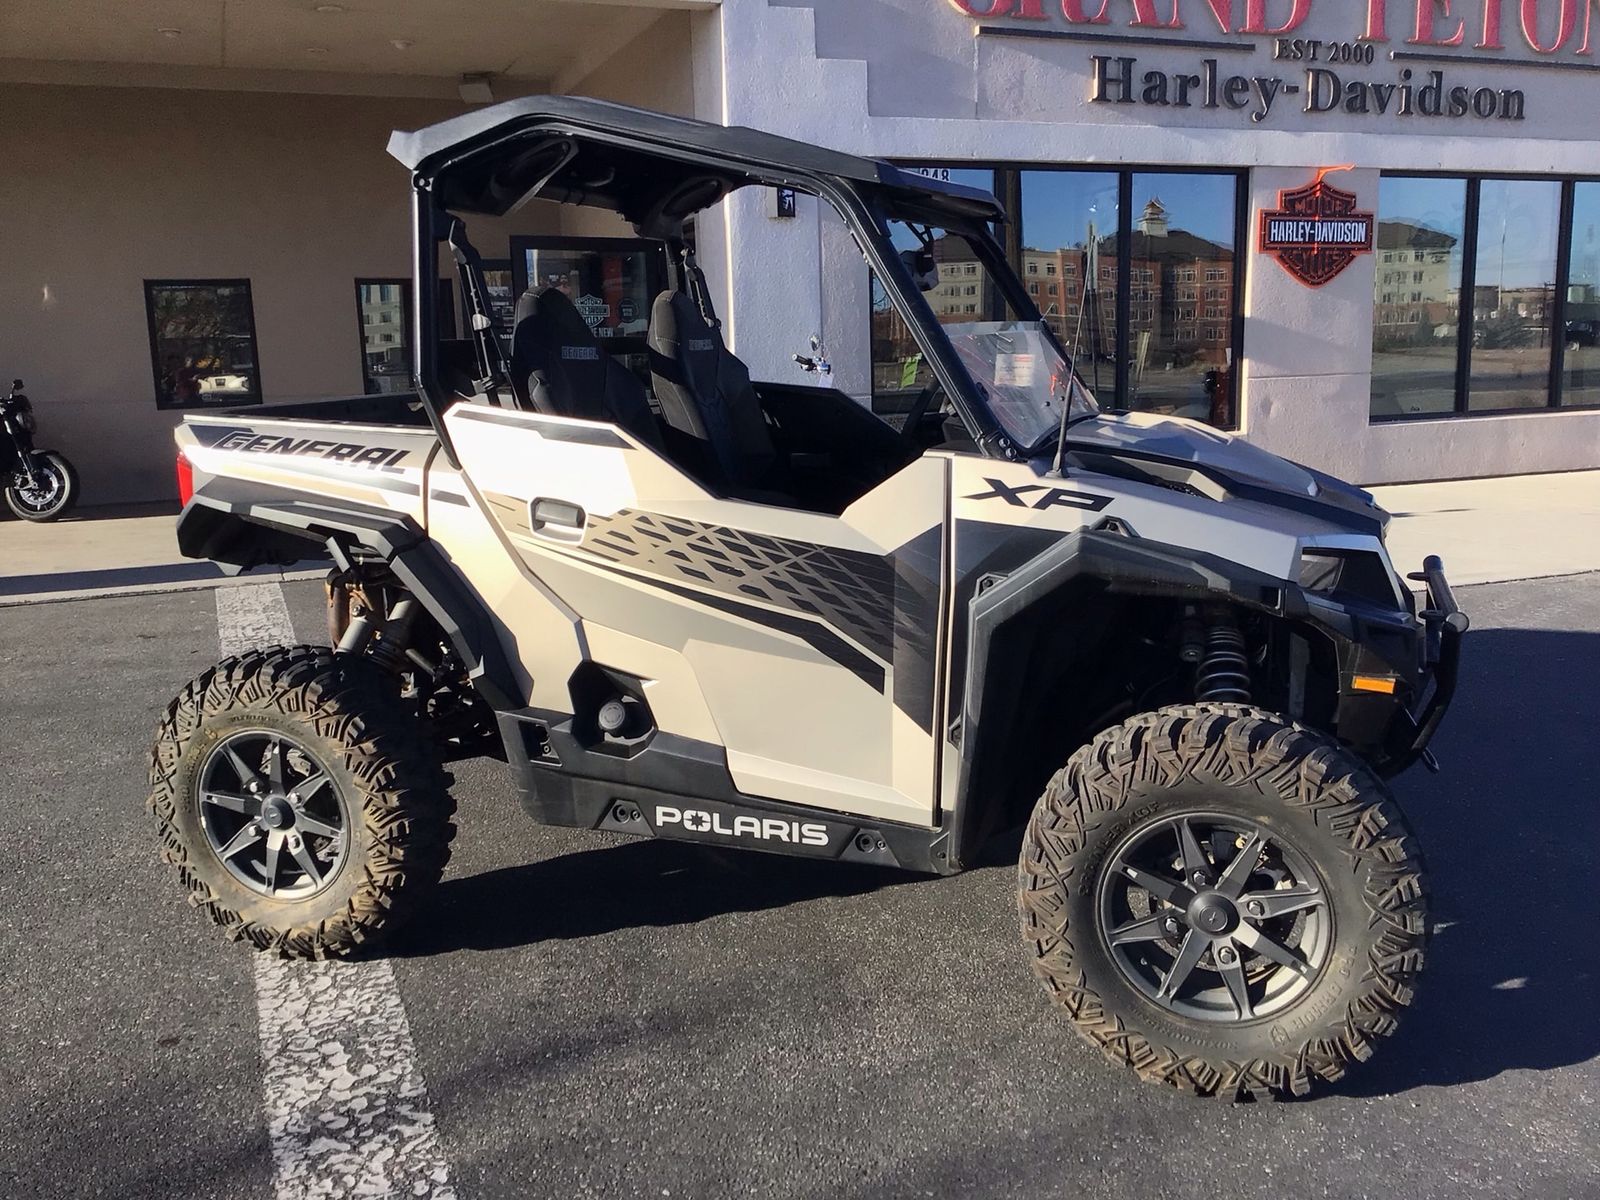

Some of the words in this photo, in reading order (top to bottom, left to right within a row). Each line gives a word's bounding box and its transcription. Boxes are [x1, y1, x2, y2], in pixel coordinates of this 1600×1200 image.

[1273, 38, 1322, 60] EST
[1328, 41, 1375, 65] 2000
[1088, 54, 1525, 122] Harley-Davidson
[1270, 221, 1367, 243] HARLEY-DAVIDSON
[210, 430, 411, 474] GENERAL
[960, 477, 1115, 512] XP
[655, 805, 829, 846] POLARIS
